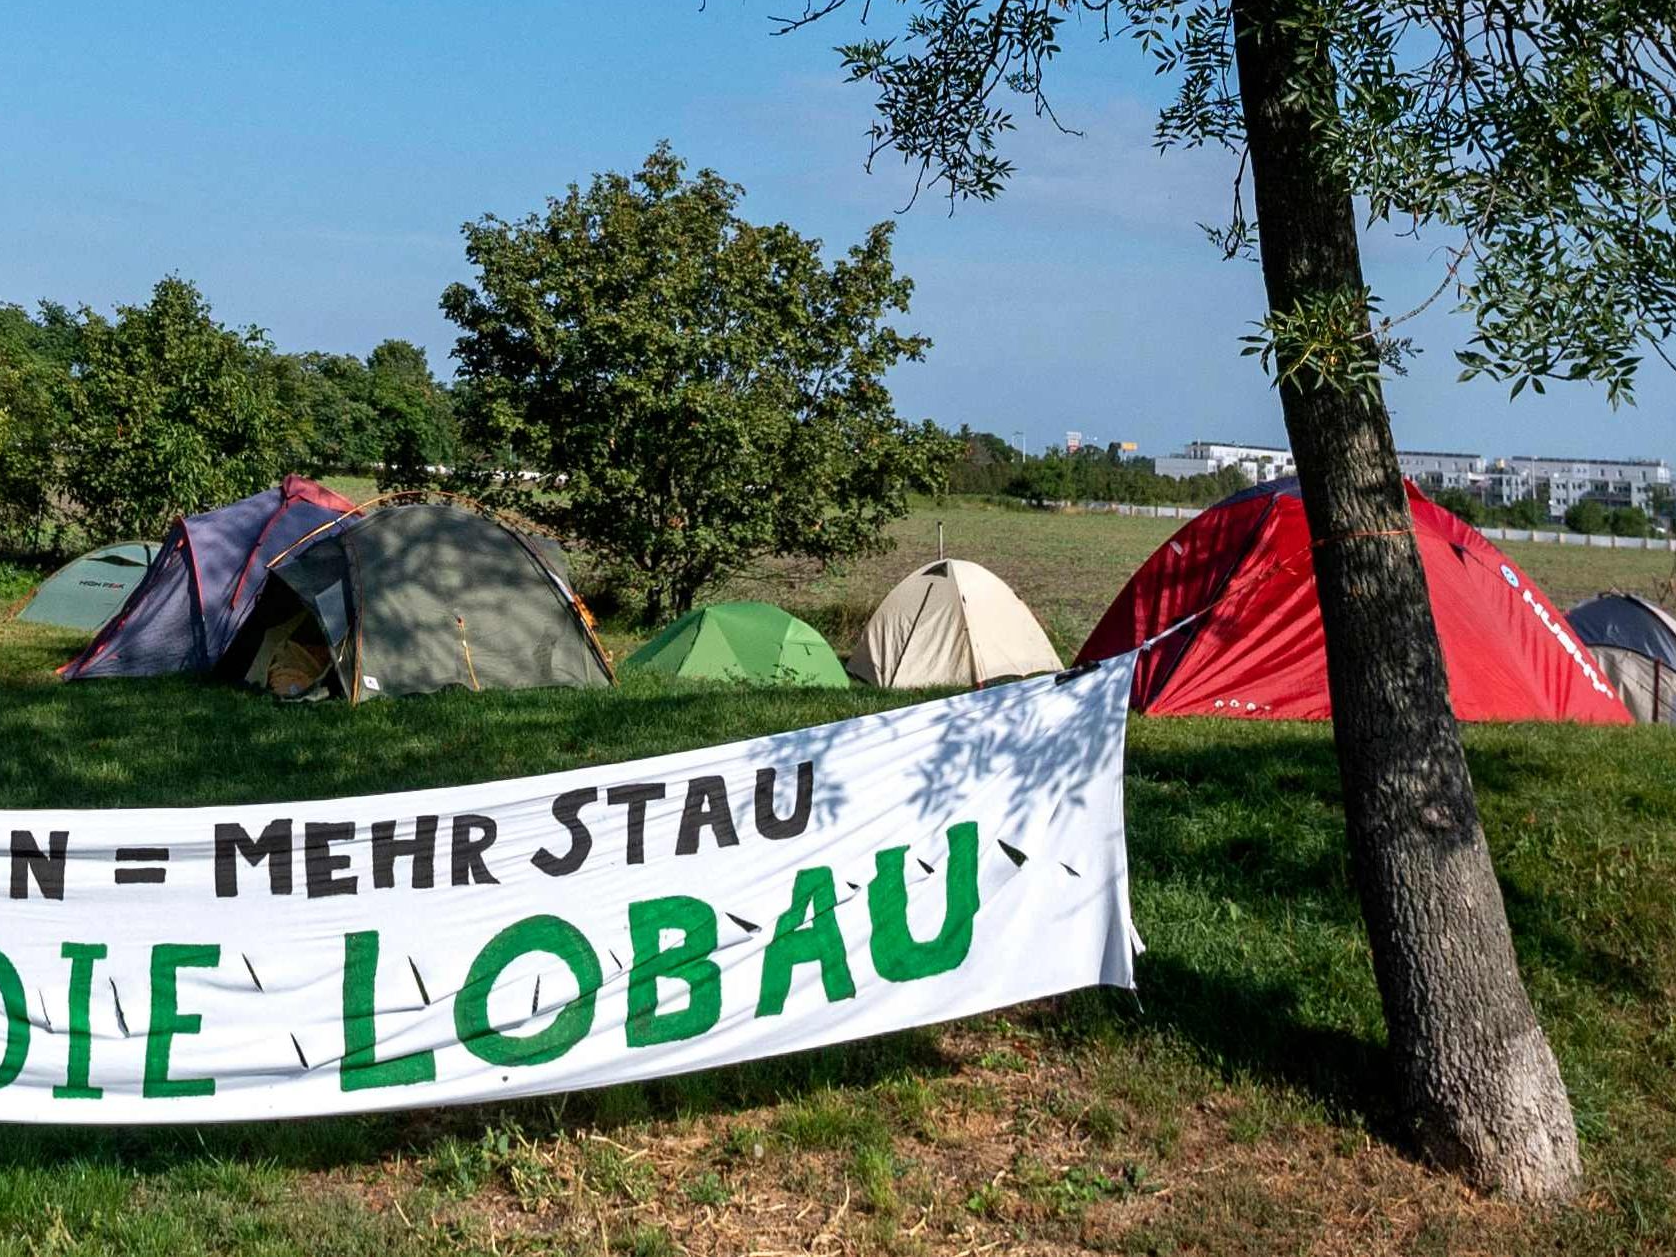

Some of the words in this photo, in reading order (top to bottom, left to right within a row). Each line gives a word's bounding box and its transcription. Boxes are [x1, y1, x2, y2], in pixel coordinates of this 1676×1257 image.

[214, 814, 501, 899] MEHR
[530, 760, 814, 877] STAU
[340, 821, 980, 1091] LOBAU
